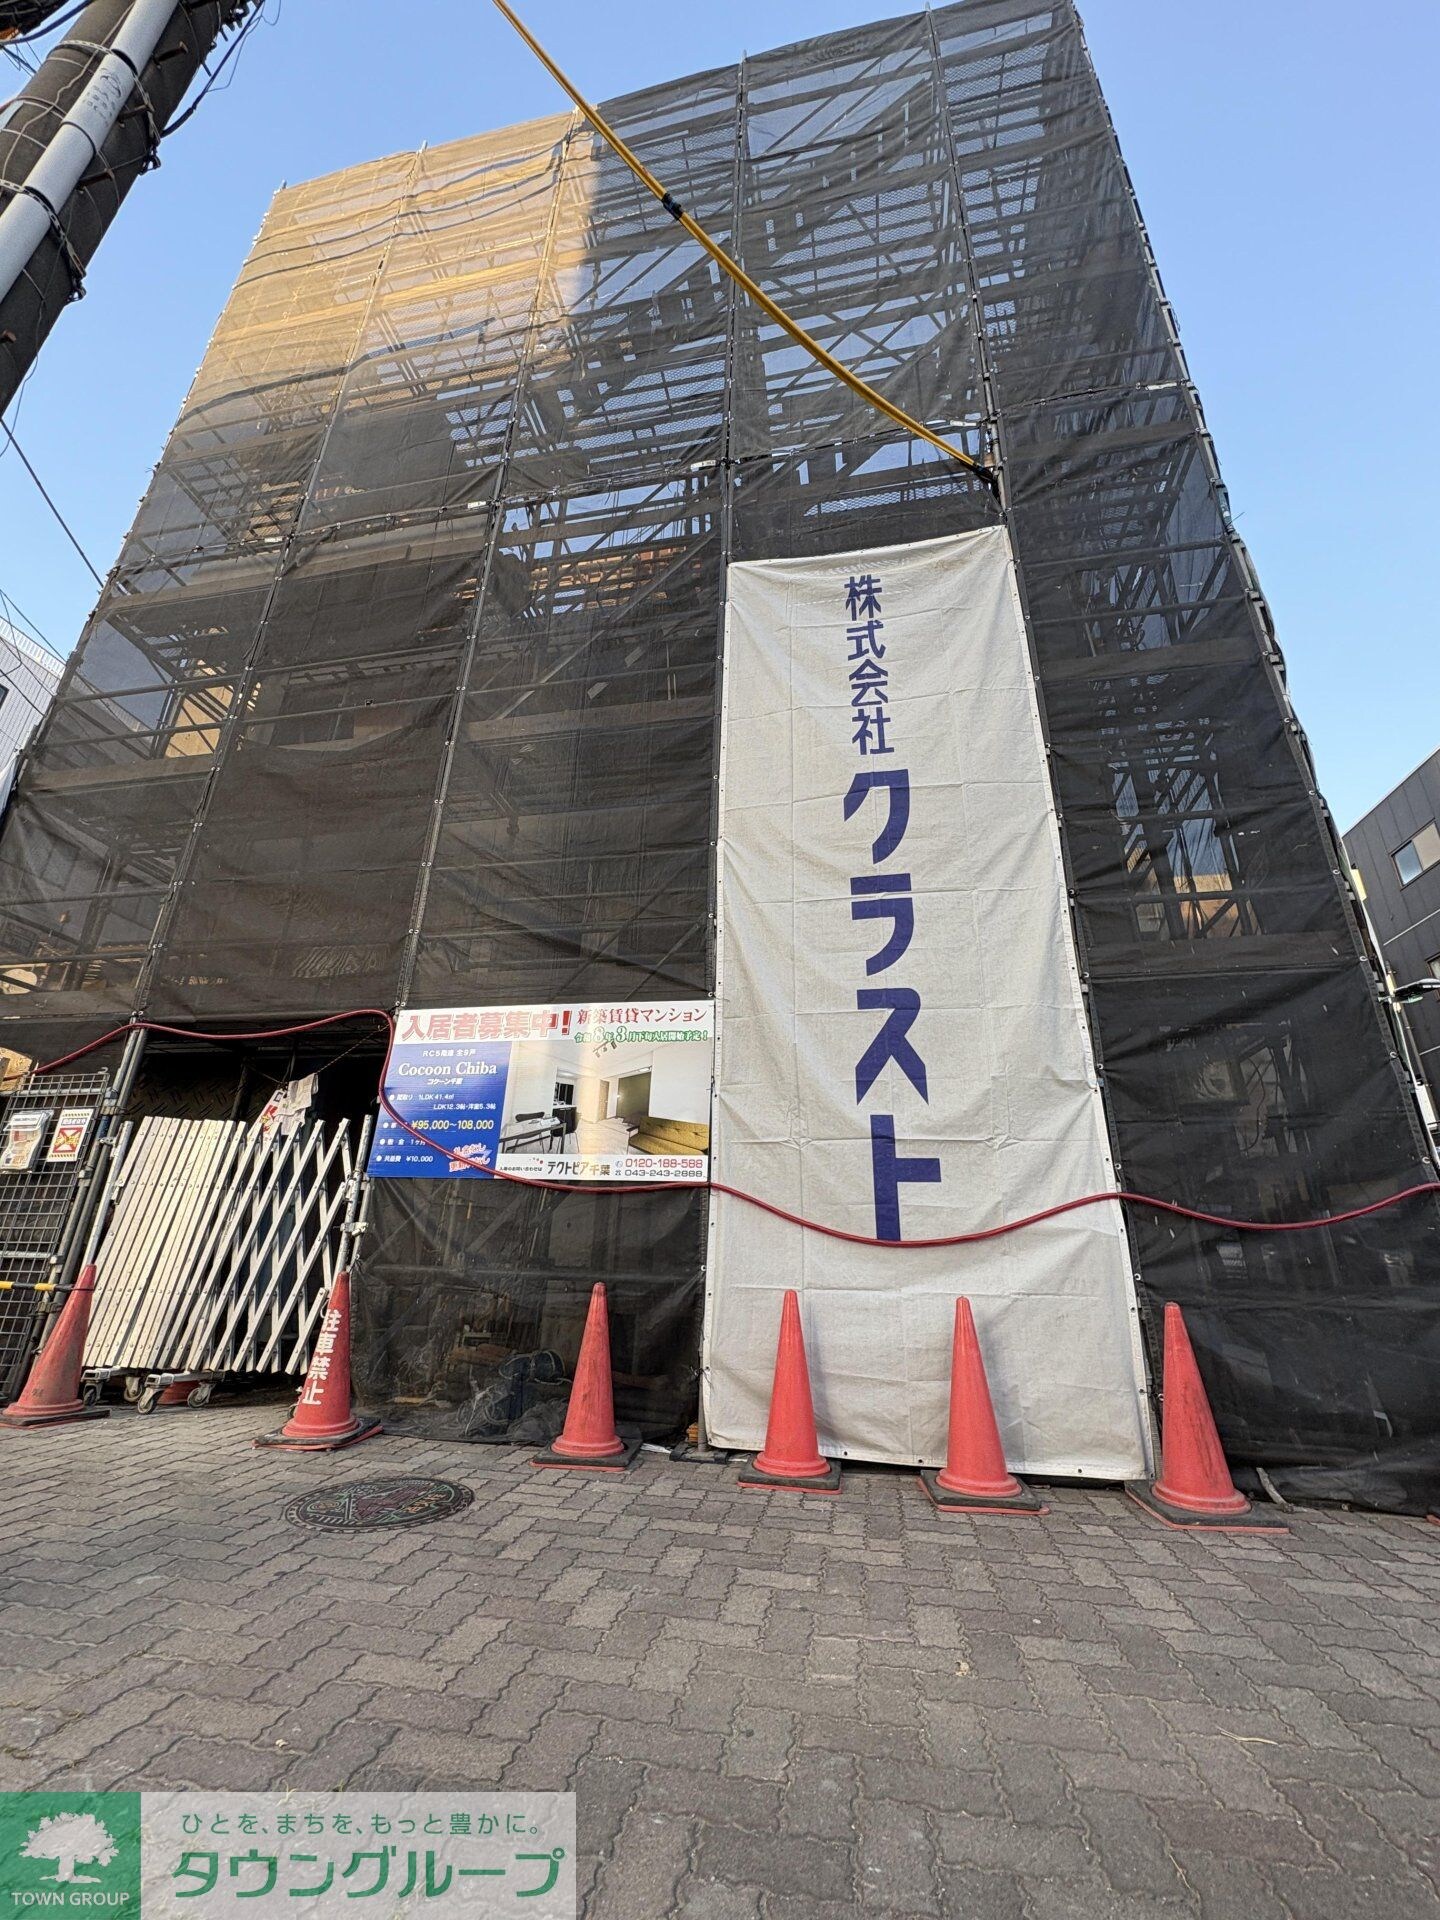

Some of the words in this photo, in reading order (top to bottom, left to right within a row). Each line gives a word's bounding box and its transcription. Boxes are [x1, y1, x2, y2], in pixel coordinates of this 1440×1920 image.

[577, 1007, 708, 1025] 新築賃貸マンション
[398, 1062, 452, 1076] Cocoon
[455, 1061, 498, 1075] Chiba
[547, 1160, 611, 1176] テクトピア千葉
[625, 1158, 704, 1169] 0120-188-588
[624, 1169, 703, 1178] 043-243-2888
[302, 1308, 342, 1405] 駐車禁止
